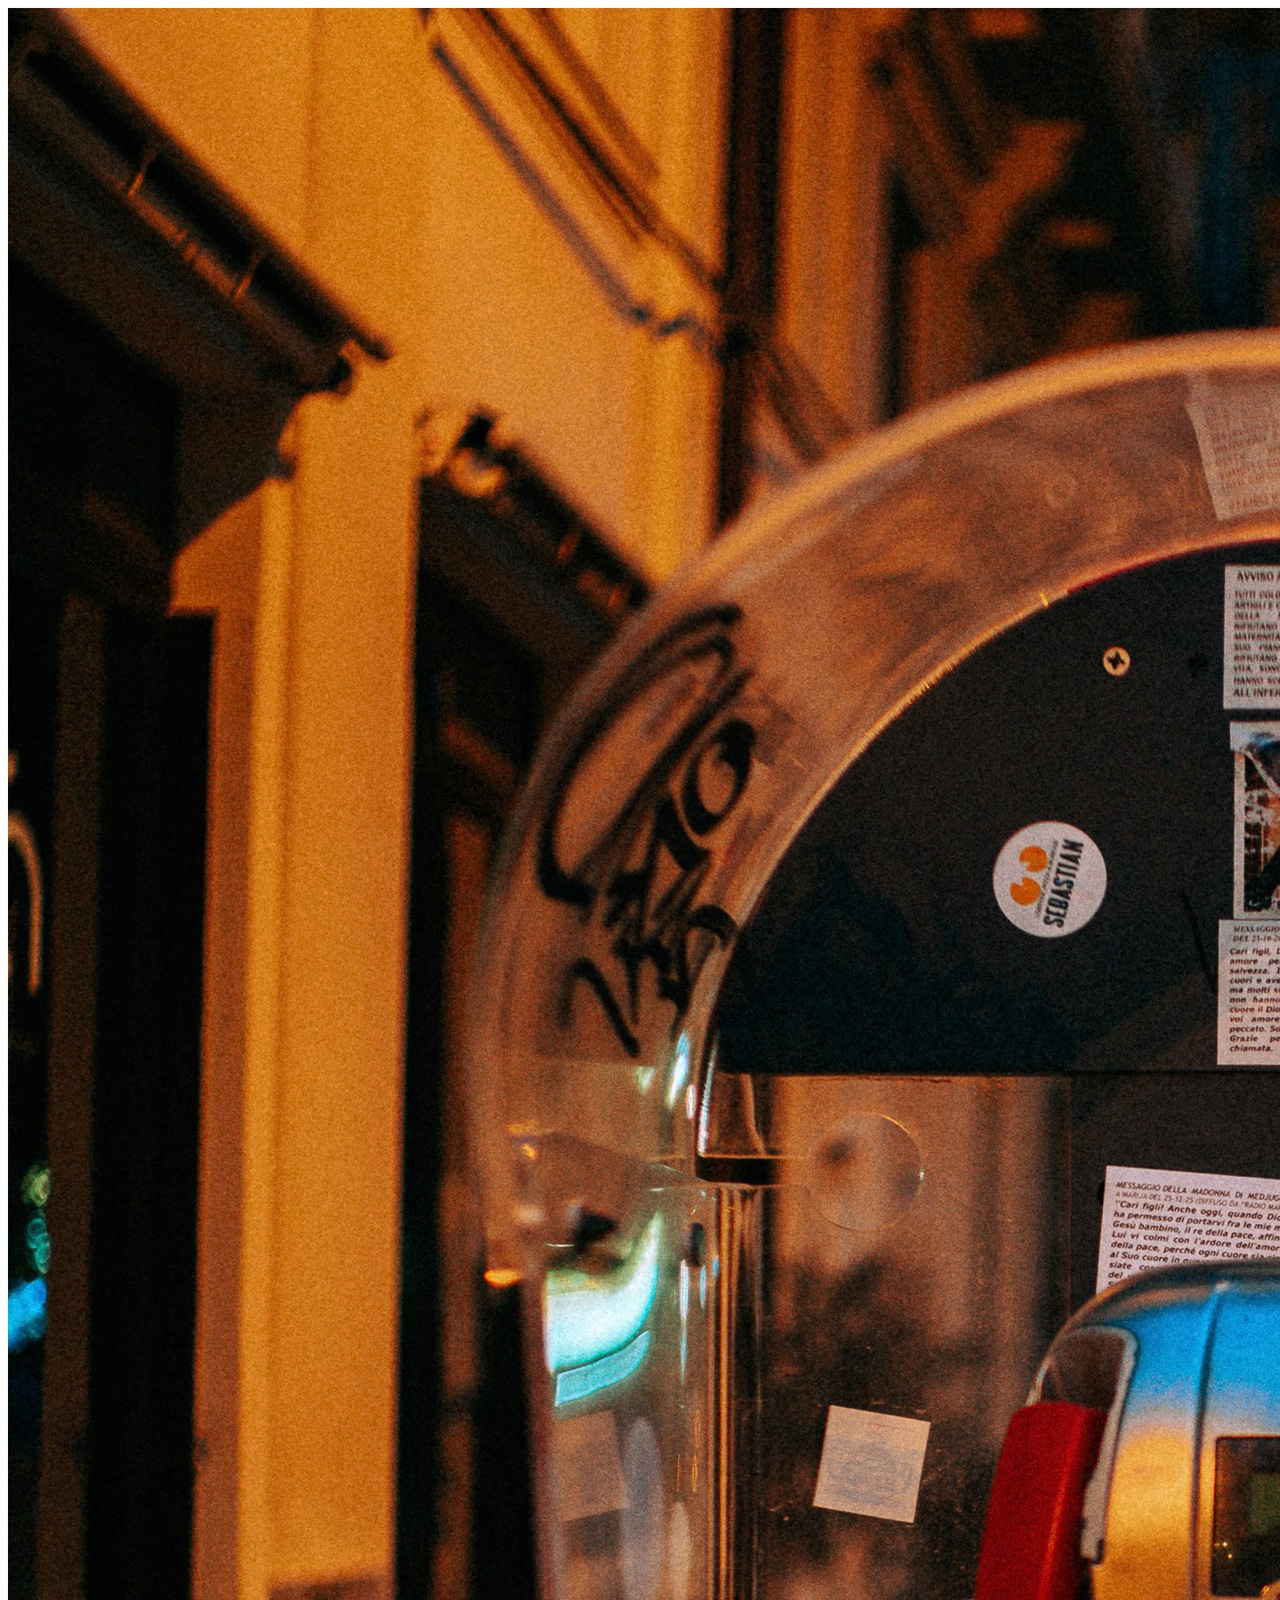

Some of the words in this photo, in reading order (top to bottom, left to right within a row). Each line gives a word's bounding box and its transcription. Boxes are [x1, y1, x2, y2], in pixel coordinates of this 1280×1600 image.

[1237, 572, 1273, 581] AVVISO
[1043, 838, 1084, 928] SEBASTIAN
[1252, 948, 1271, 956] figli,
[1116, 1181, 1161, 1191] MESSAGGIO
[1162, 1185, 1187, 1193] DELLA
[1191, 1188, 1230, 1197] MADONNA
[1142, 1202, 1164, 1212] figli!
[1167, 1204, 1196, 1213] Anche
[1201, 1208, 1223, 1217] oggi,
[1228, 1211, 1263, 1219] quando
[1127, 1213, 1173, 1222] permesso
[1186, 1218, 1225, 1226] portarvi
[1227, 1220, 1240, 1228] fra
[1113, 1221, 1135, 1229] Gesù
[1138, 1223, 1181, 1234] bambino,
[1205, 1228, 1228, 1237] della
[1231, 1232, 1255, 1240] pace,
[1112, 1231, 1126, 1239] Lui
[1143, 1234, 1169, 1242] colmi
[1194, 1238, 1231, 1247] l'ardore
[1111, 1241, 1133, 1249] della
[1136, 1244, 1160, 1253] pace,
[1199, 1249, 1219, 1257] ogni
[1121, 1252, 1139, 1260] Suo
[1109, 1261, 1132, 1270] siate
[1108, 1271, 1123, 1279] del
